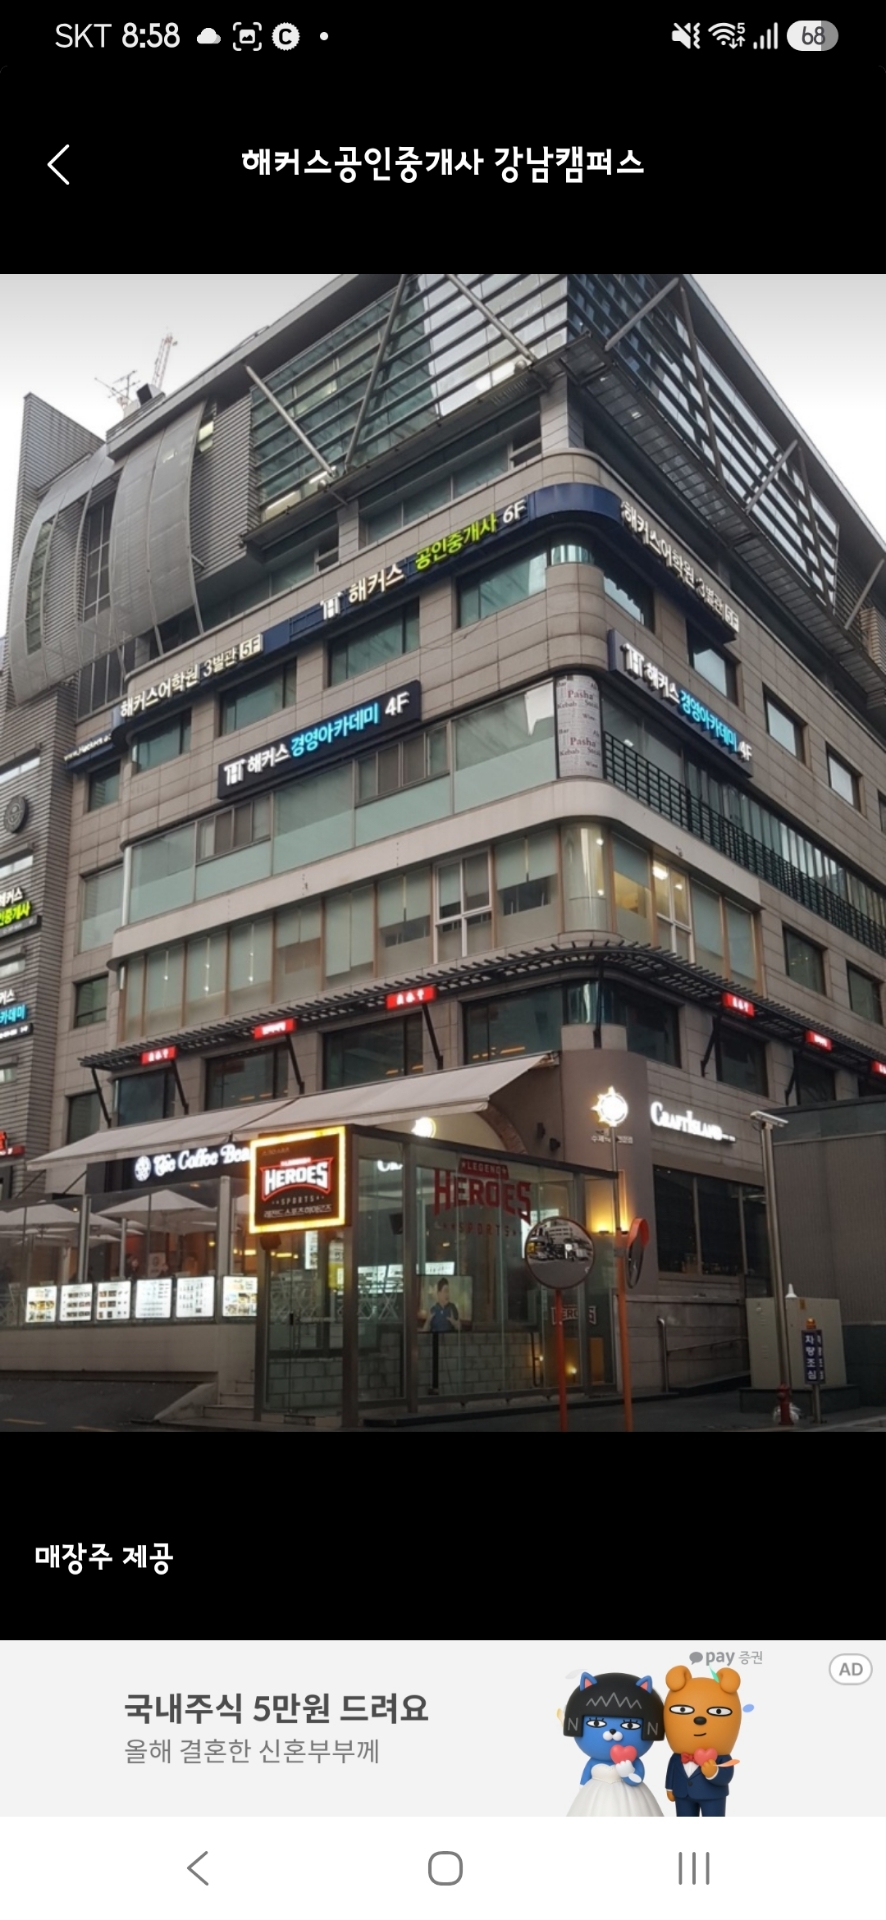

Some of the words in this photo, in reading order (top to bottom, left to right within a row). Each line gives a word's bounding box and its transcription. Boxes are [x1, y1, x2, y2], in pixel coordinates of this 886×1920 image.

[348, 563, 406, 604] 해커스
[414, 513, 497, 570] 공인중개사
[502, 499, 527, 524] 6F
[621, 501, 695, 590] 해커스어학원
[120, 663, 199, 717] 해커스어학원
[240, 635, 261, 660] 5F
[247, 743, 291, 773] 해커스
[290, 702, 380, 758] 경영아카데미
[384, 691, 410, 716] 4F
[644, 661, 680, 704] 해커스
[679, 690, 738, 753] 경영아카데미
[153, 1154, 176, 1176] The
[178, 1147, 218, 1170] Coffee
[264, 1161, 329, 1196] HEROES
[281, 1195, 314, 1205] SPORTS
[433, 1168, 531, 1226] HEROES
[459, 1222, 509, 1237] SPORTS
[805, 1335, 817, 1380] 차량조심
